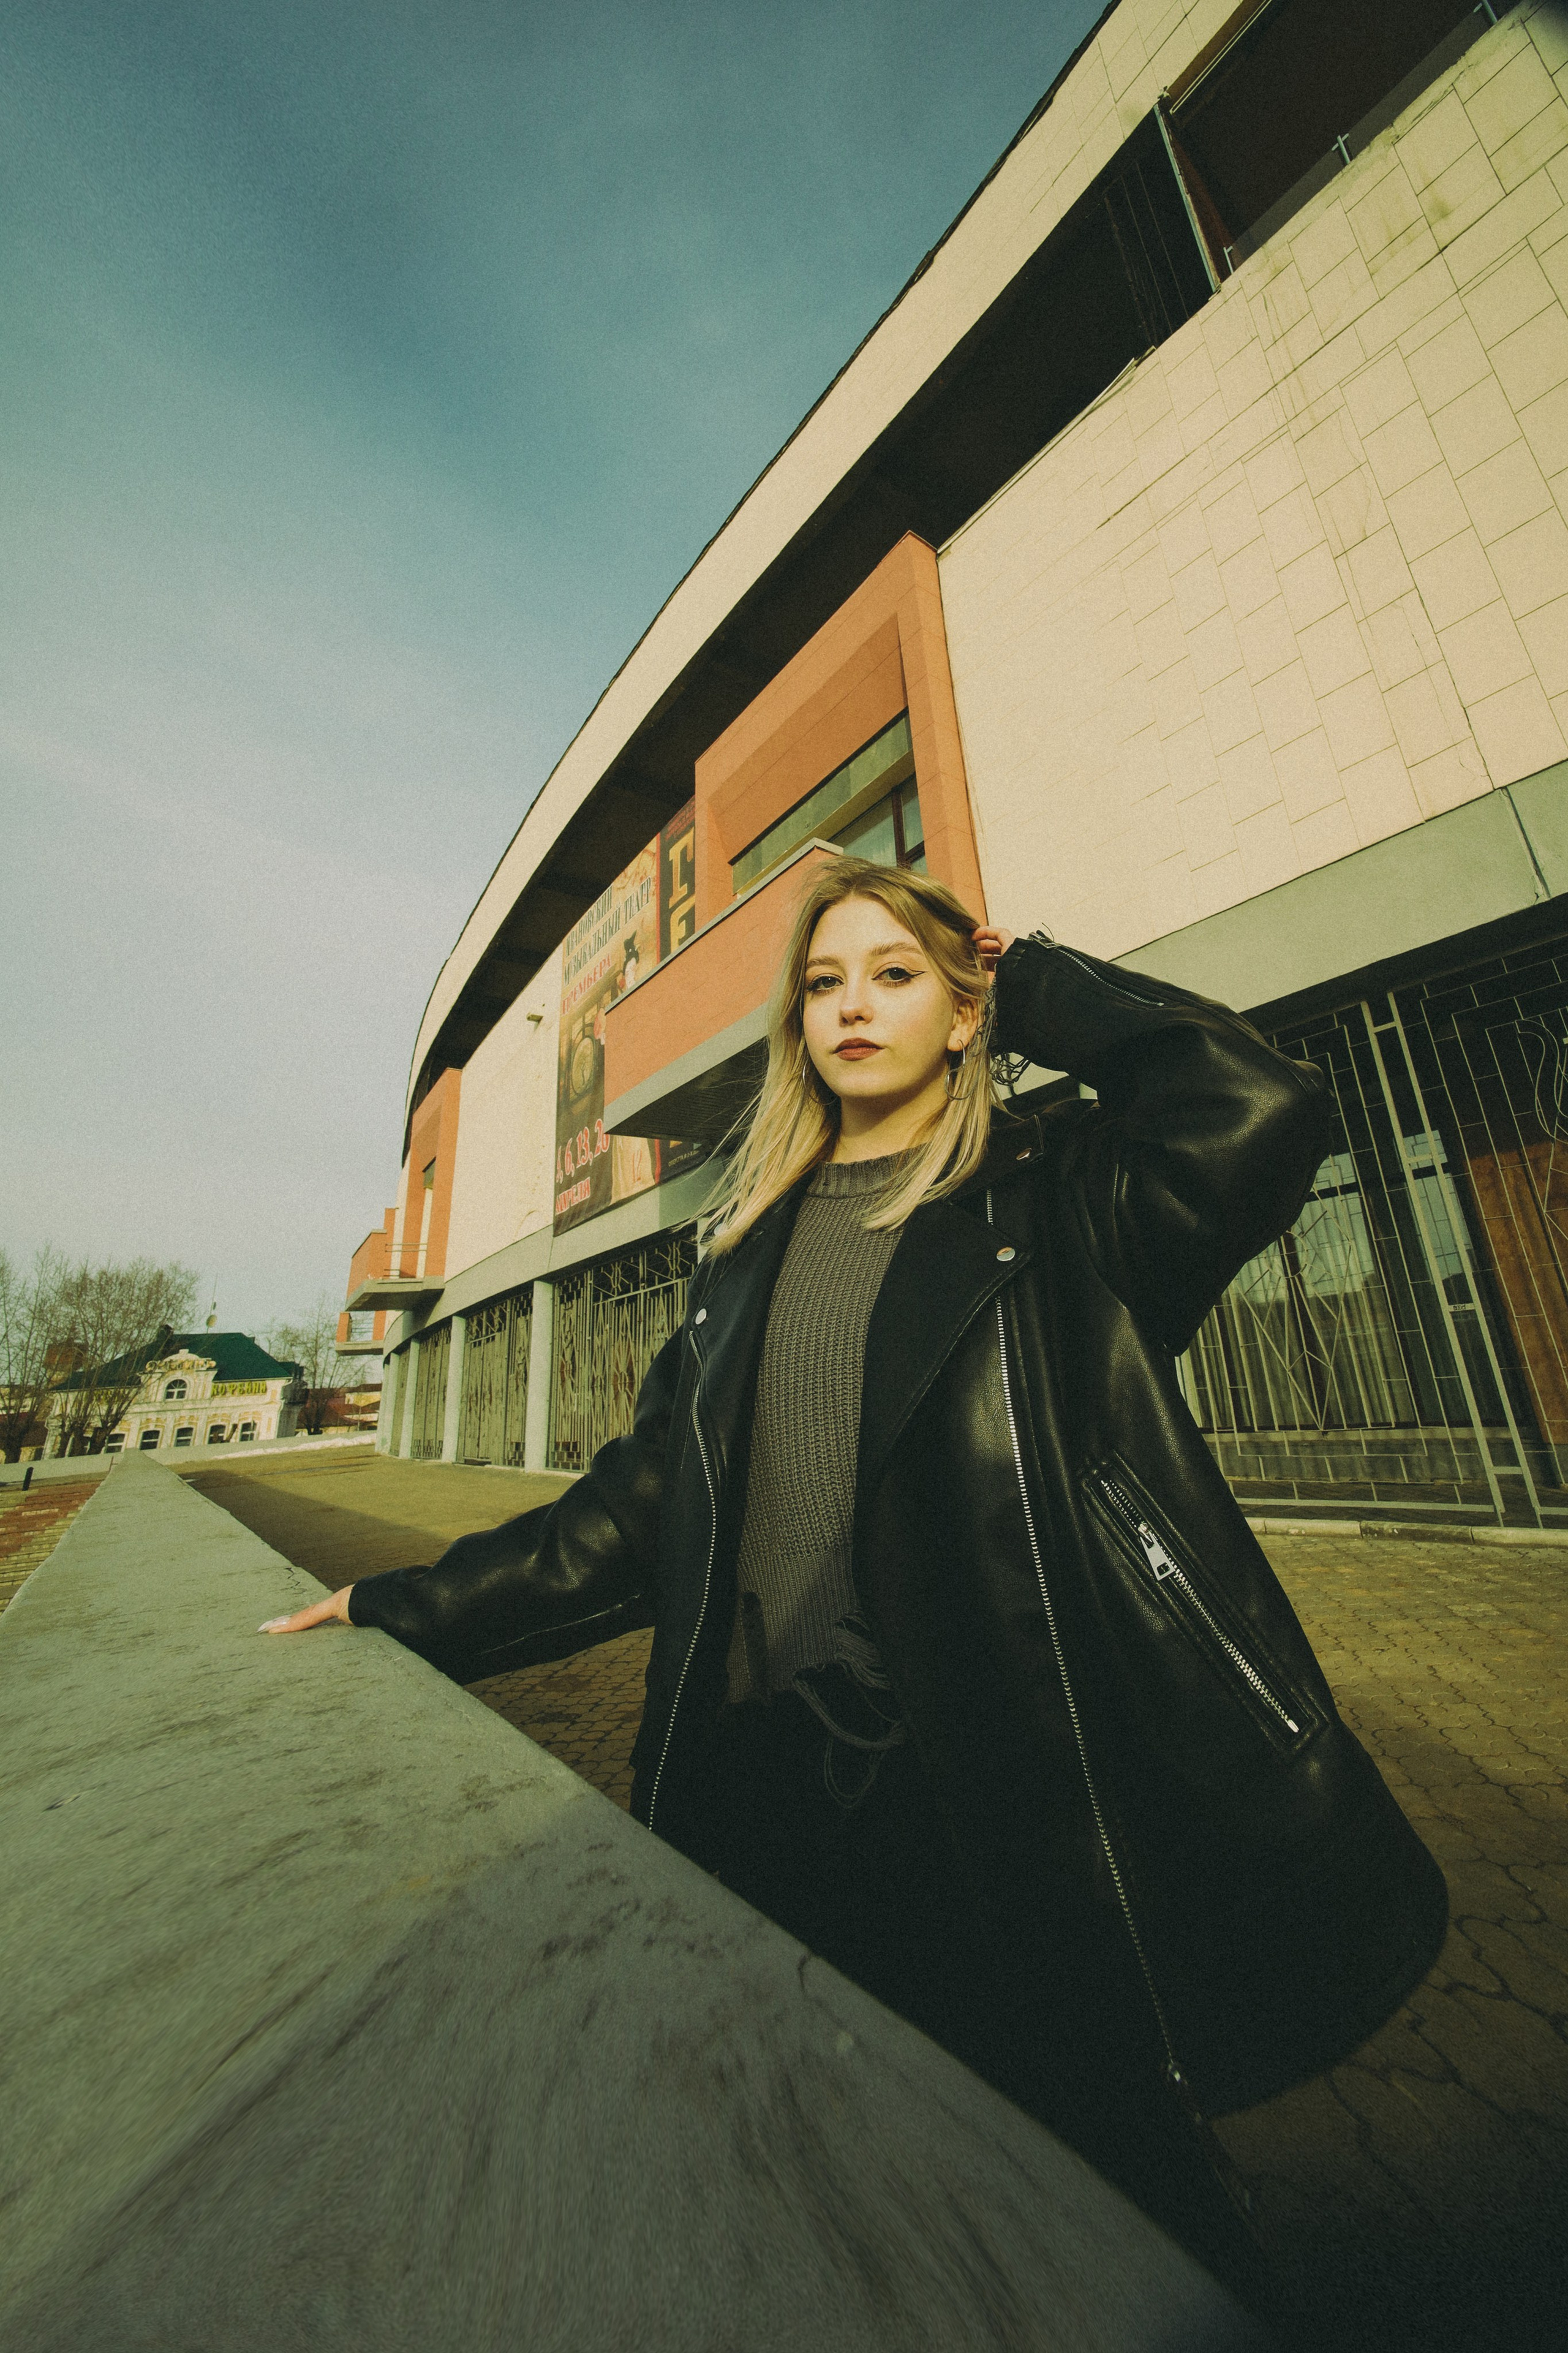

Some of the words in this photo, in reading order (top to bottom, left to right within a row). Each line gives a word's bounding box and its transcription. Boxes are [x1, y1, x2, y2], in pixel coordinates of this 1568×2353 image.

[564, 902, 621, 986] МУЗЫКАЛЬНЫЙ
[624, 876, 652, 925] ТЕАТР
[562, 953, 611, 1016] ПРЕМЬЕРА
[565, 1137, 575, 1177] 6,
[576, 1127, 594, 1168] 13,
[555, 1176, 590, 1215] АПРЕЛЯ
